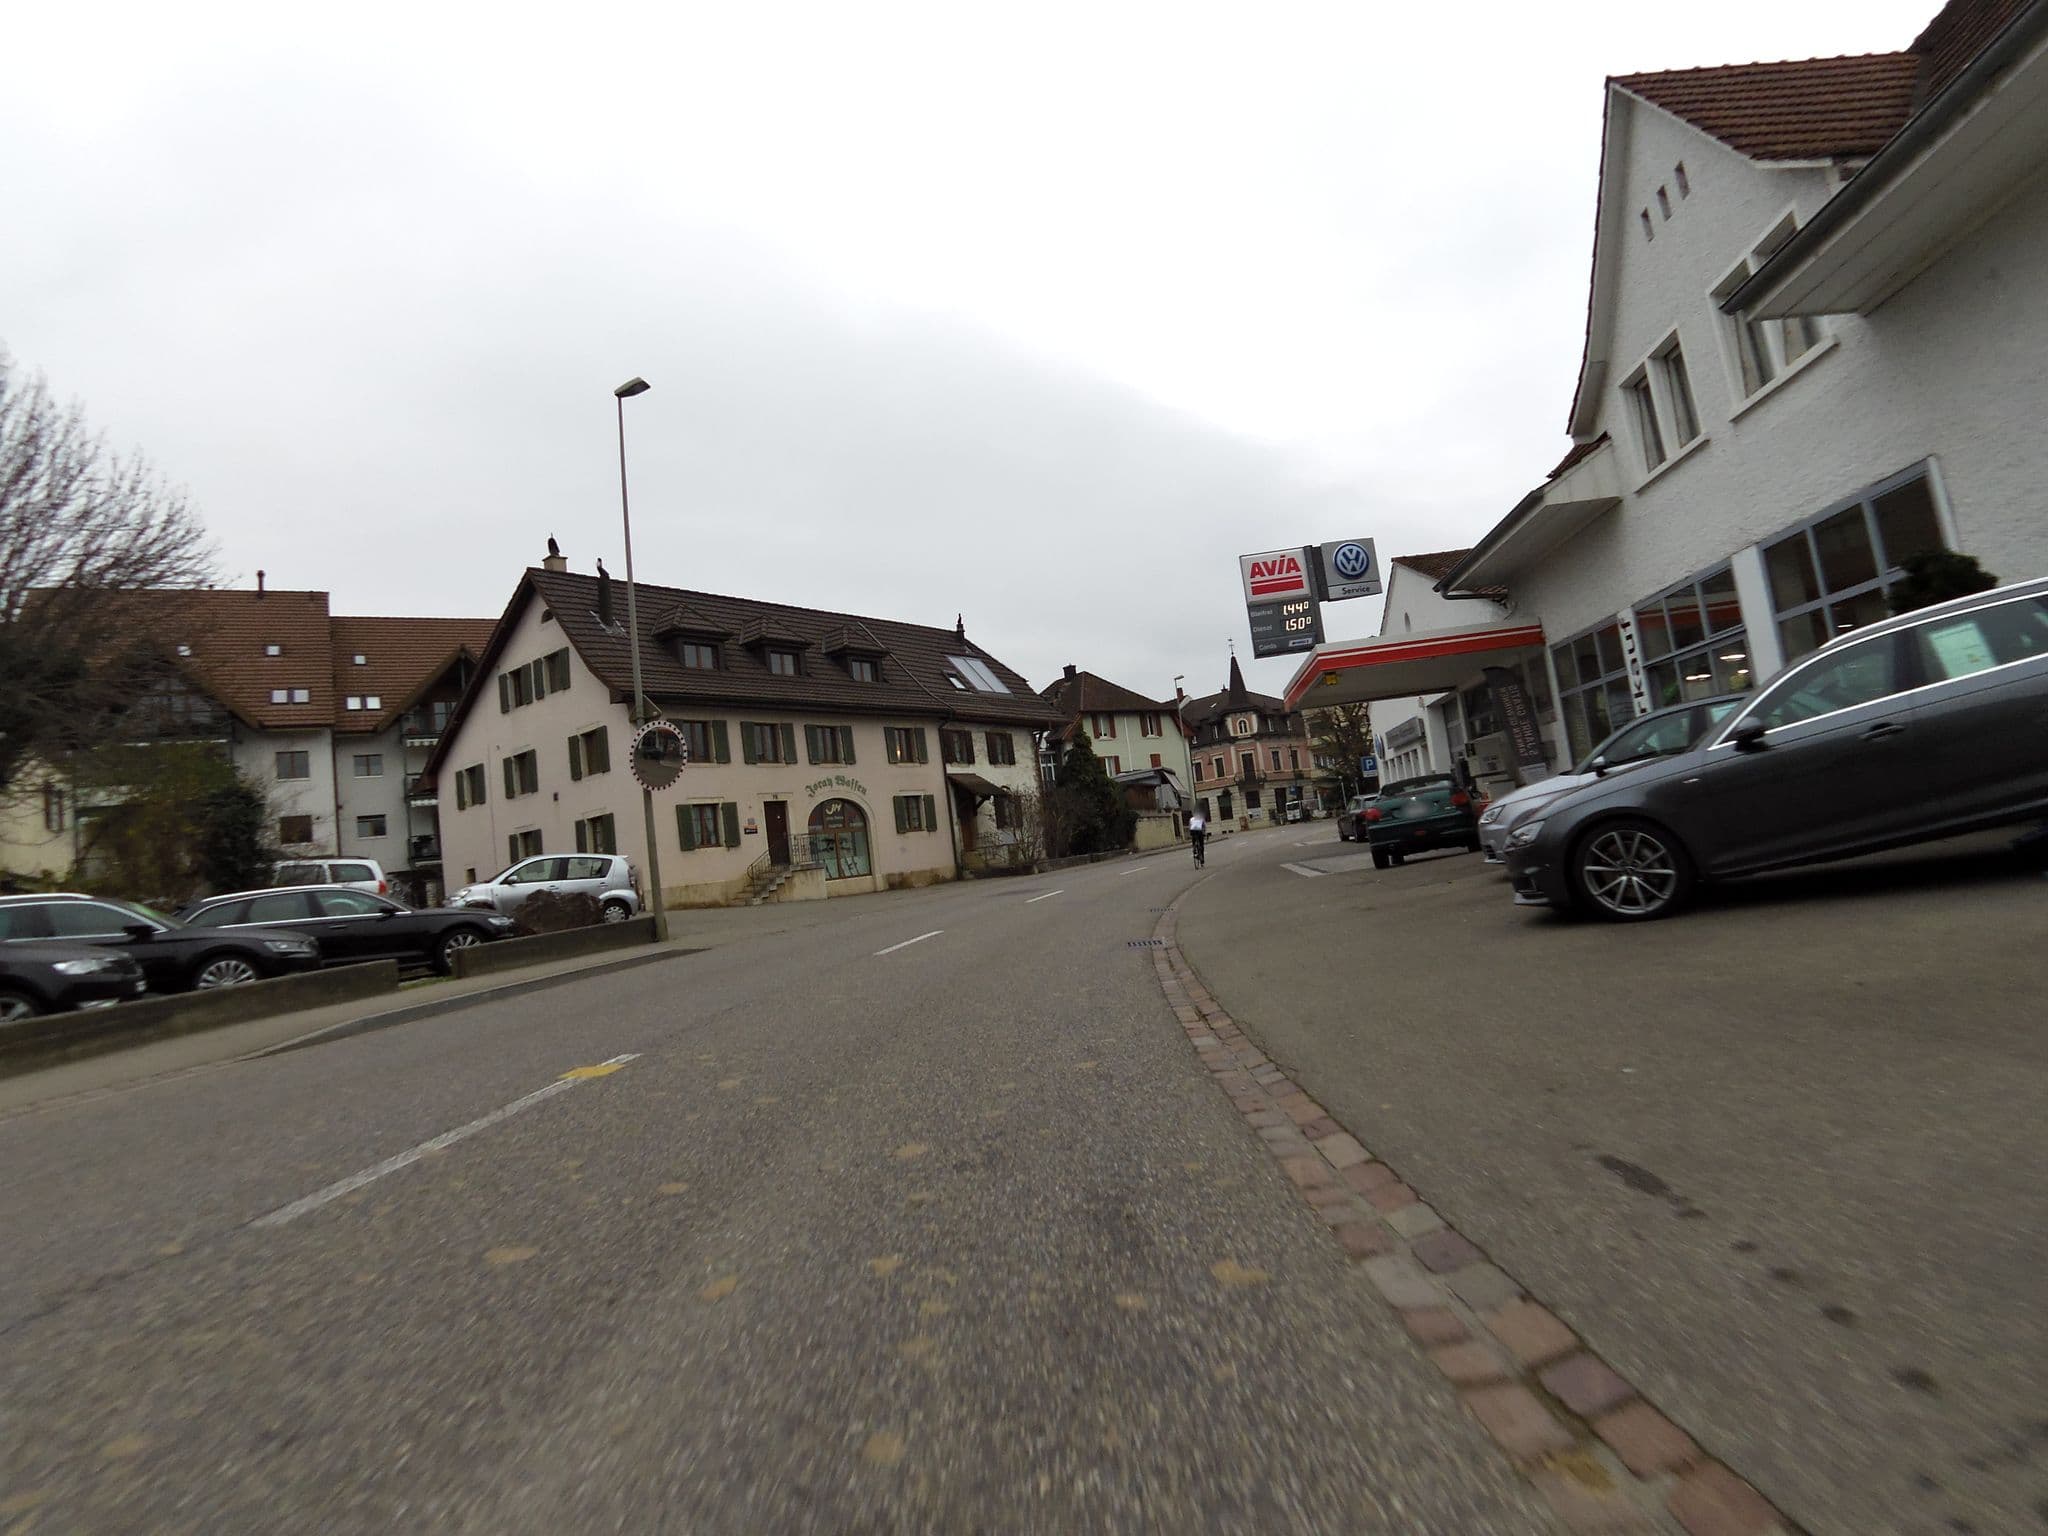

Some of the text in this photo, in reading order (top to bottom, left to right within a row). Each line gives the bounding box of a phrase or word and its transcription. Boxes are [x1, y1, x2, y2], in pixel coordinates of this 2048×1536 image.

[1250, 555, 1302, 579] AVIA
[1342, 586, 1371, 595] Service
[1253, 625, 1273, 633] Diesel
[1619, 617, 1648, 715] rkauf
[1365, 759, 1374, 770] P
